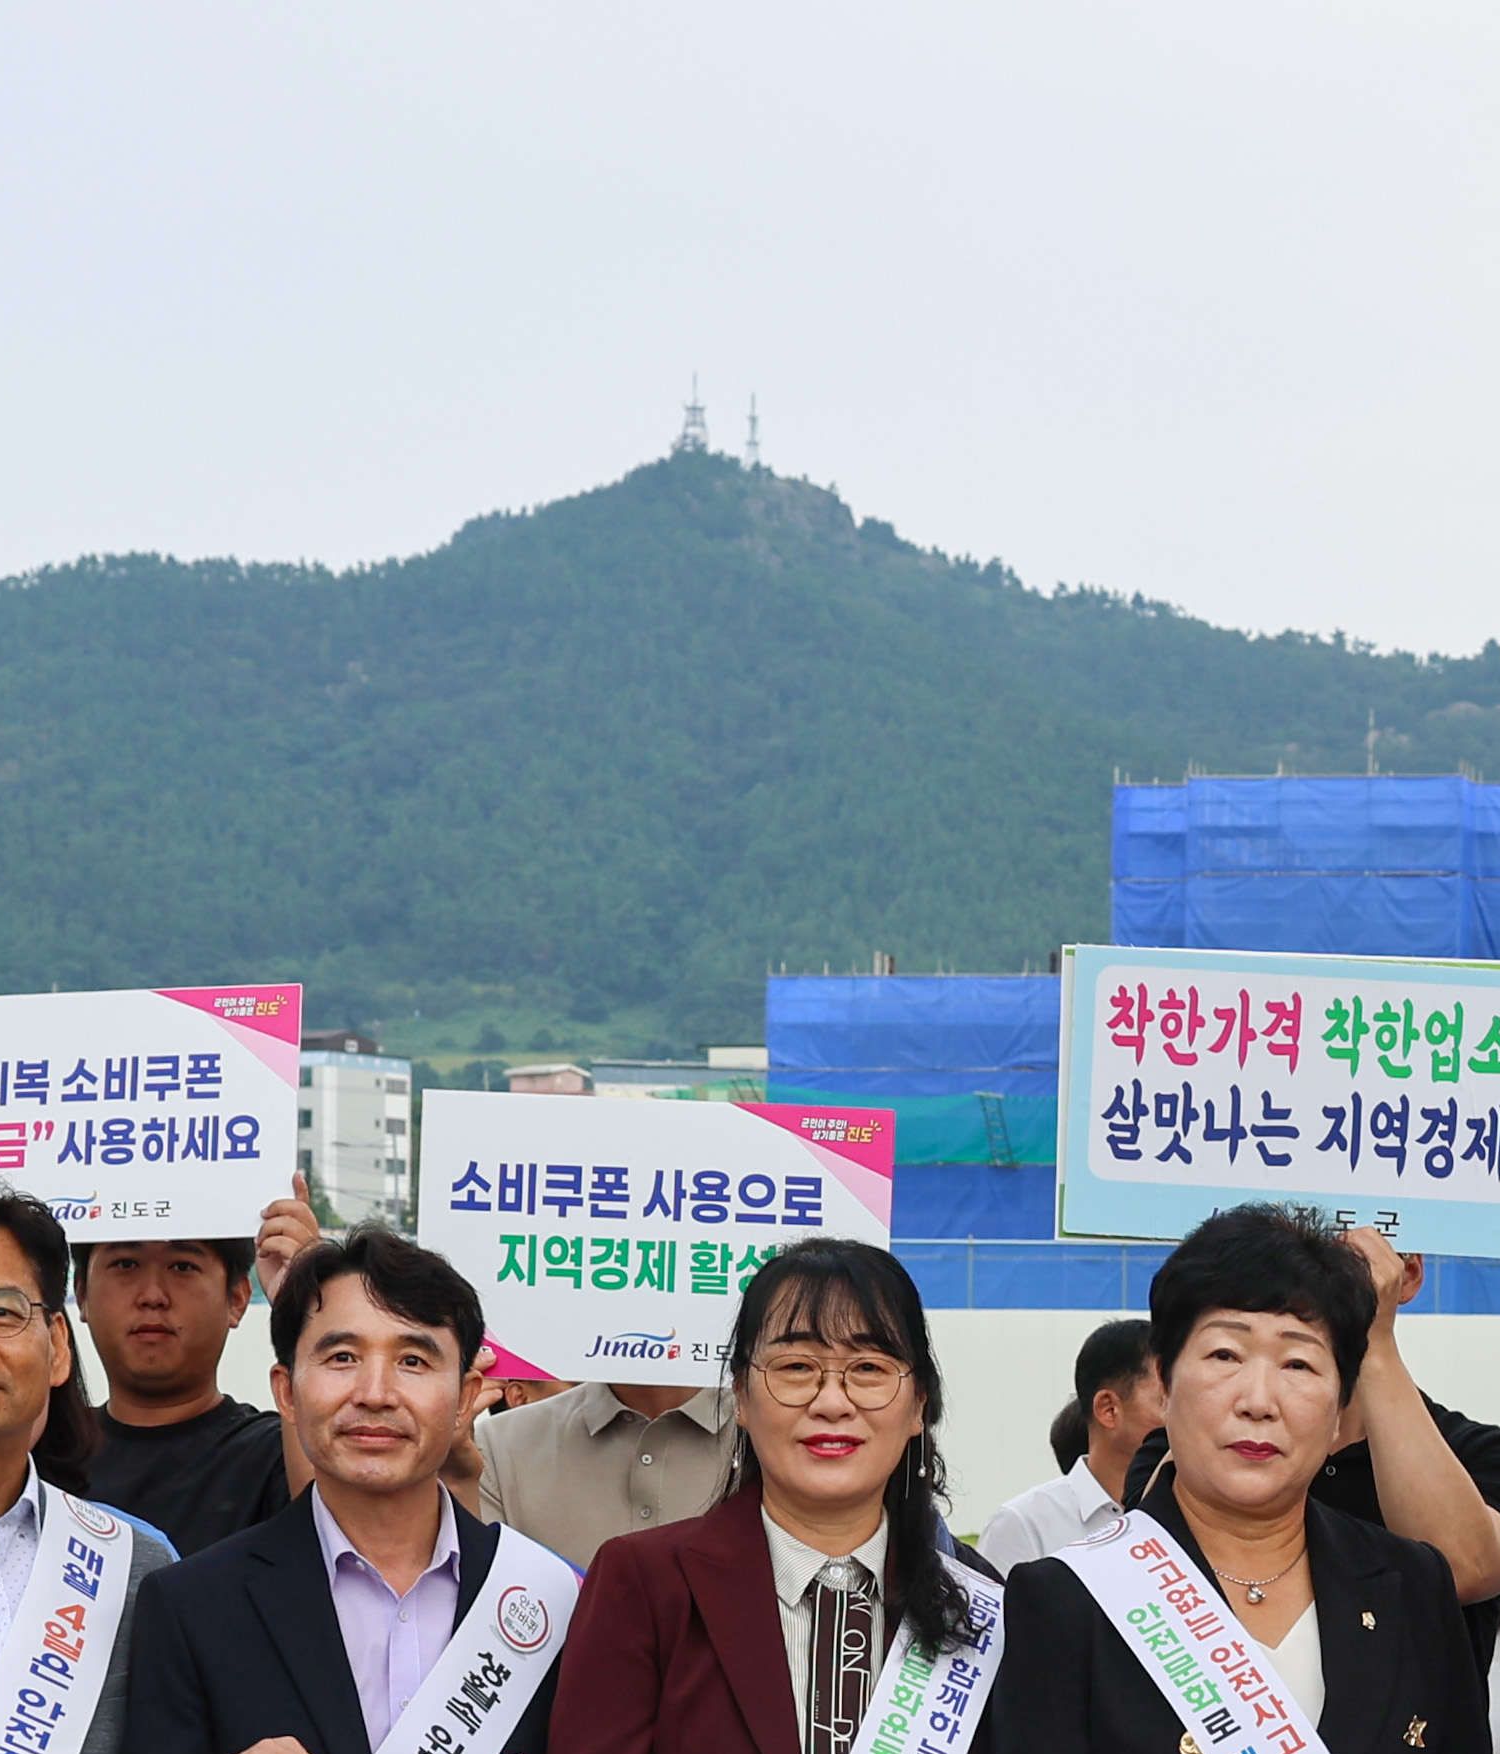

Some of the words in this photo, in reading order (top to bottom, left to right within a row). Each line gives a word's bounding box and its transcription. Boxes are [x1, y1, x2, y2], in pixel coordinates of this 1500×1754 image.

[256, 1001, 279, 1016] 진도
[1106, 983, 1303, 1075] 착한가격
[61, 1054, 222, 1102] 소비쿠폰
[58, 1115, 260, 1165] 사용하세요
[847, 1126, 873, 1143] 진도
[1101, 1078, 1300, 1166] 살맛나는
[111, 1201, 171, 1218] 진도군
[450, 1161, 630, 1219] 소비쿠폰
[643, 1170, 823, 1226] 사용으로
[497, 1234, 676, 1293] 지역경제
[585, 1334, 666, 1360] Jindo
[62, 1536, 104, 1601] 매월
[1129, 1537, 1225, 1642] 예고없는
[520, 1595, 539, 1618] 안전
[29, 1604, 86, 1690] 4일은
[1126, 1602, 1241, 1745] 안전문화로
